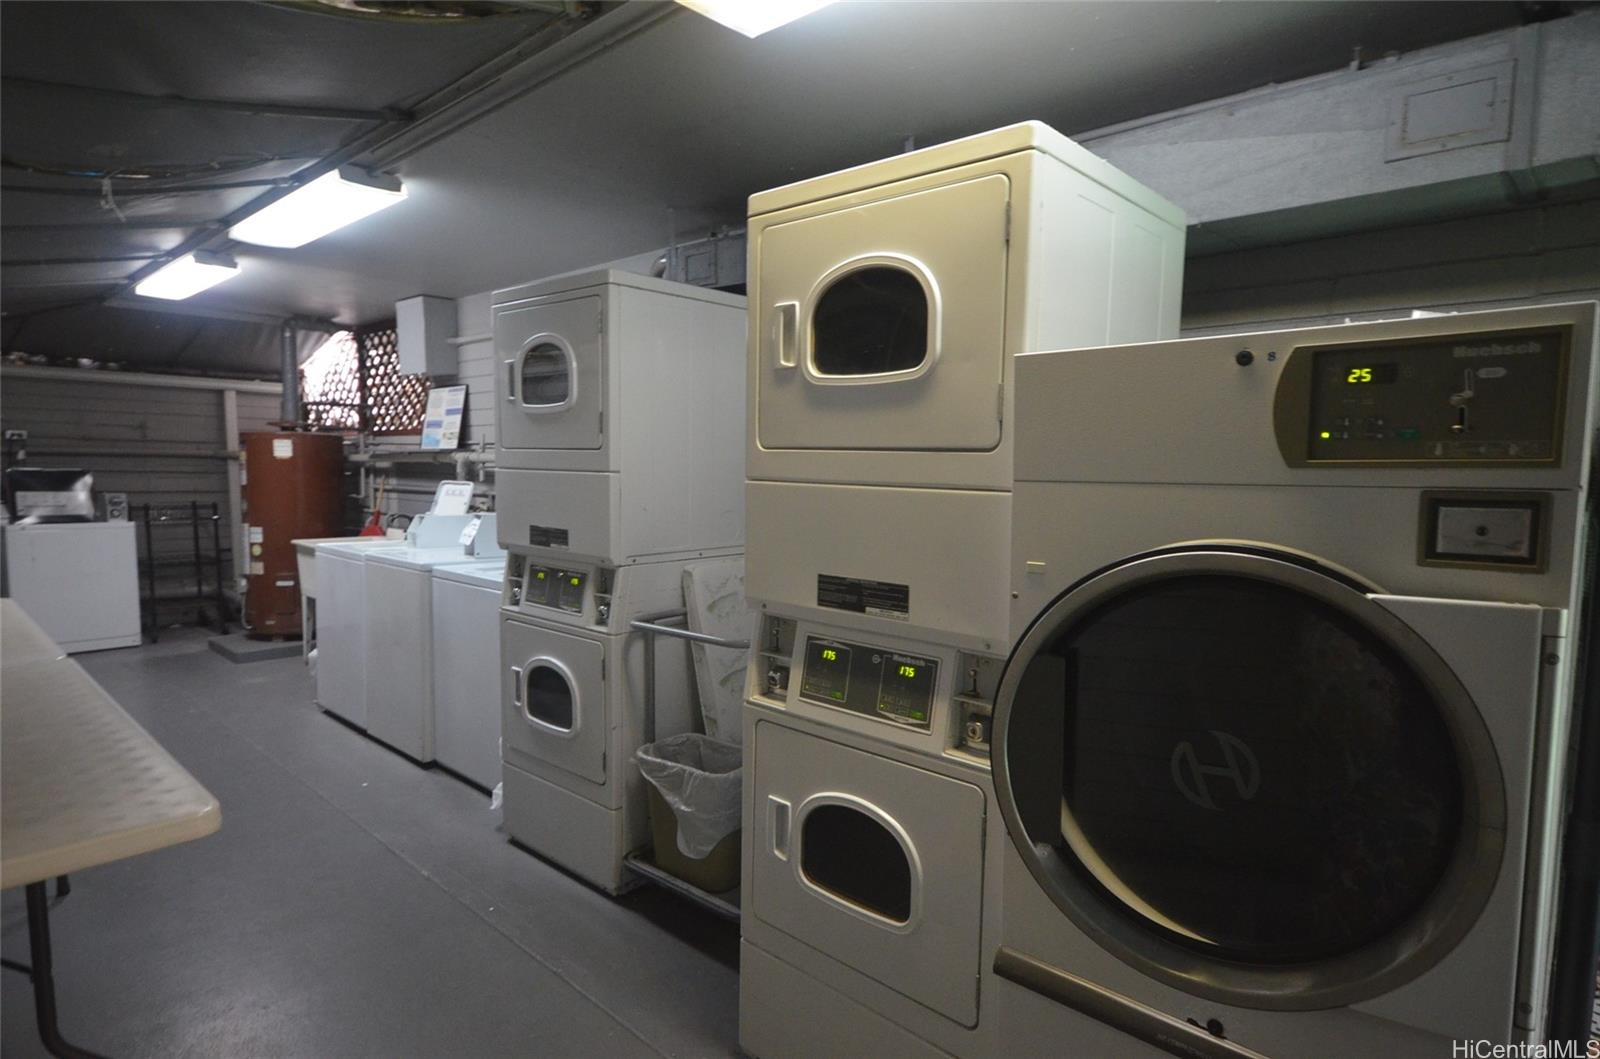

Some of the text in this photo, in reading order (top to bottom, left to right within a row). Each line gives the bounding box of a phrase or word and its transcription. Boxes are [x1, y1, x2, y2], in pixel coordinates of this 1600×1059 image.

[1346, 368, 1372, 384] 25
[822, 649, 837, 661] 175
[899, 665, 915, 678] 175
